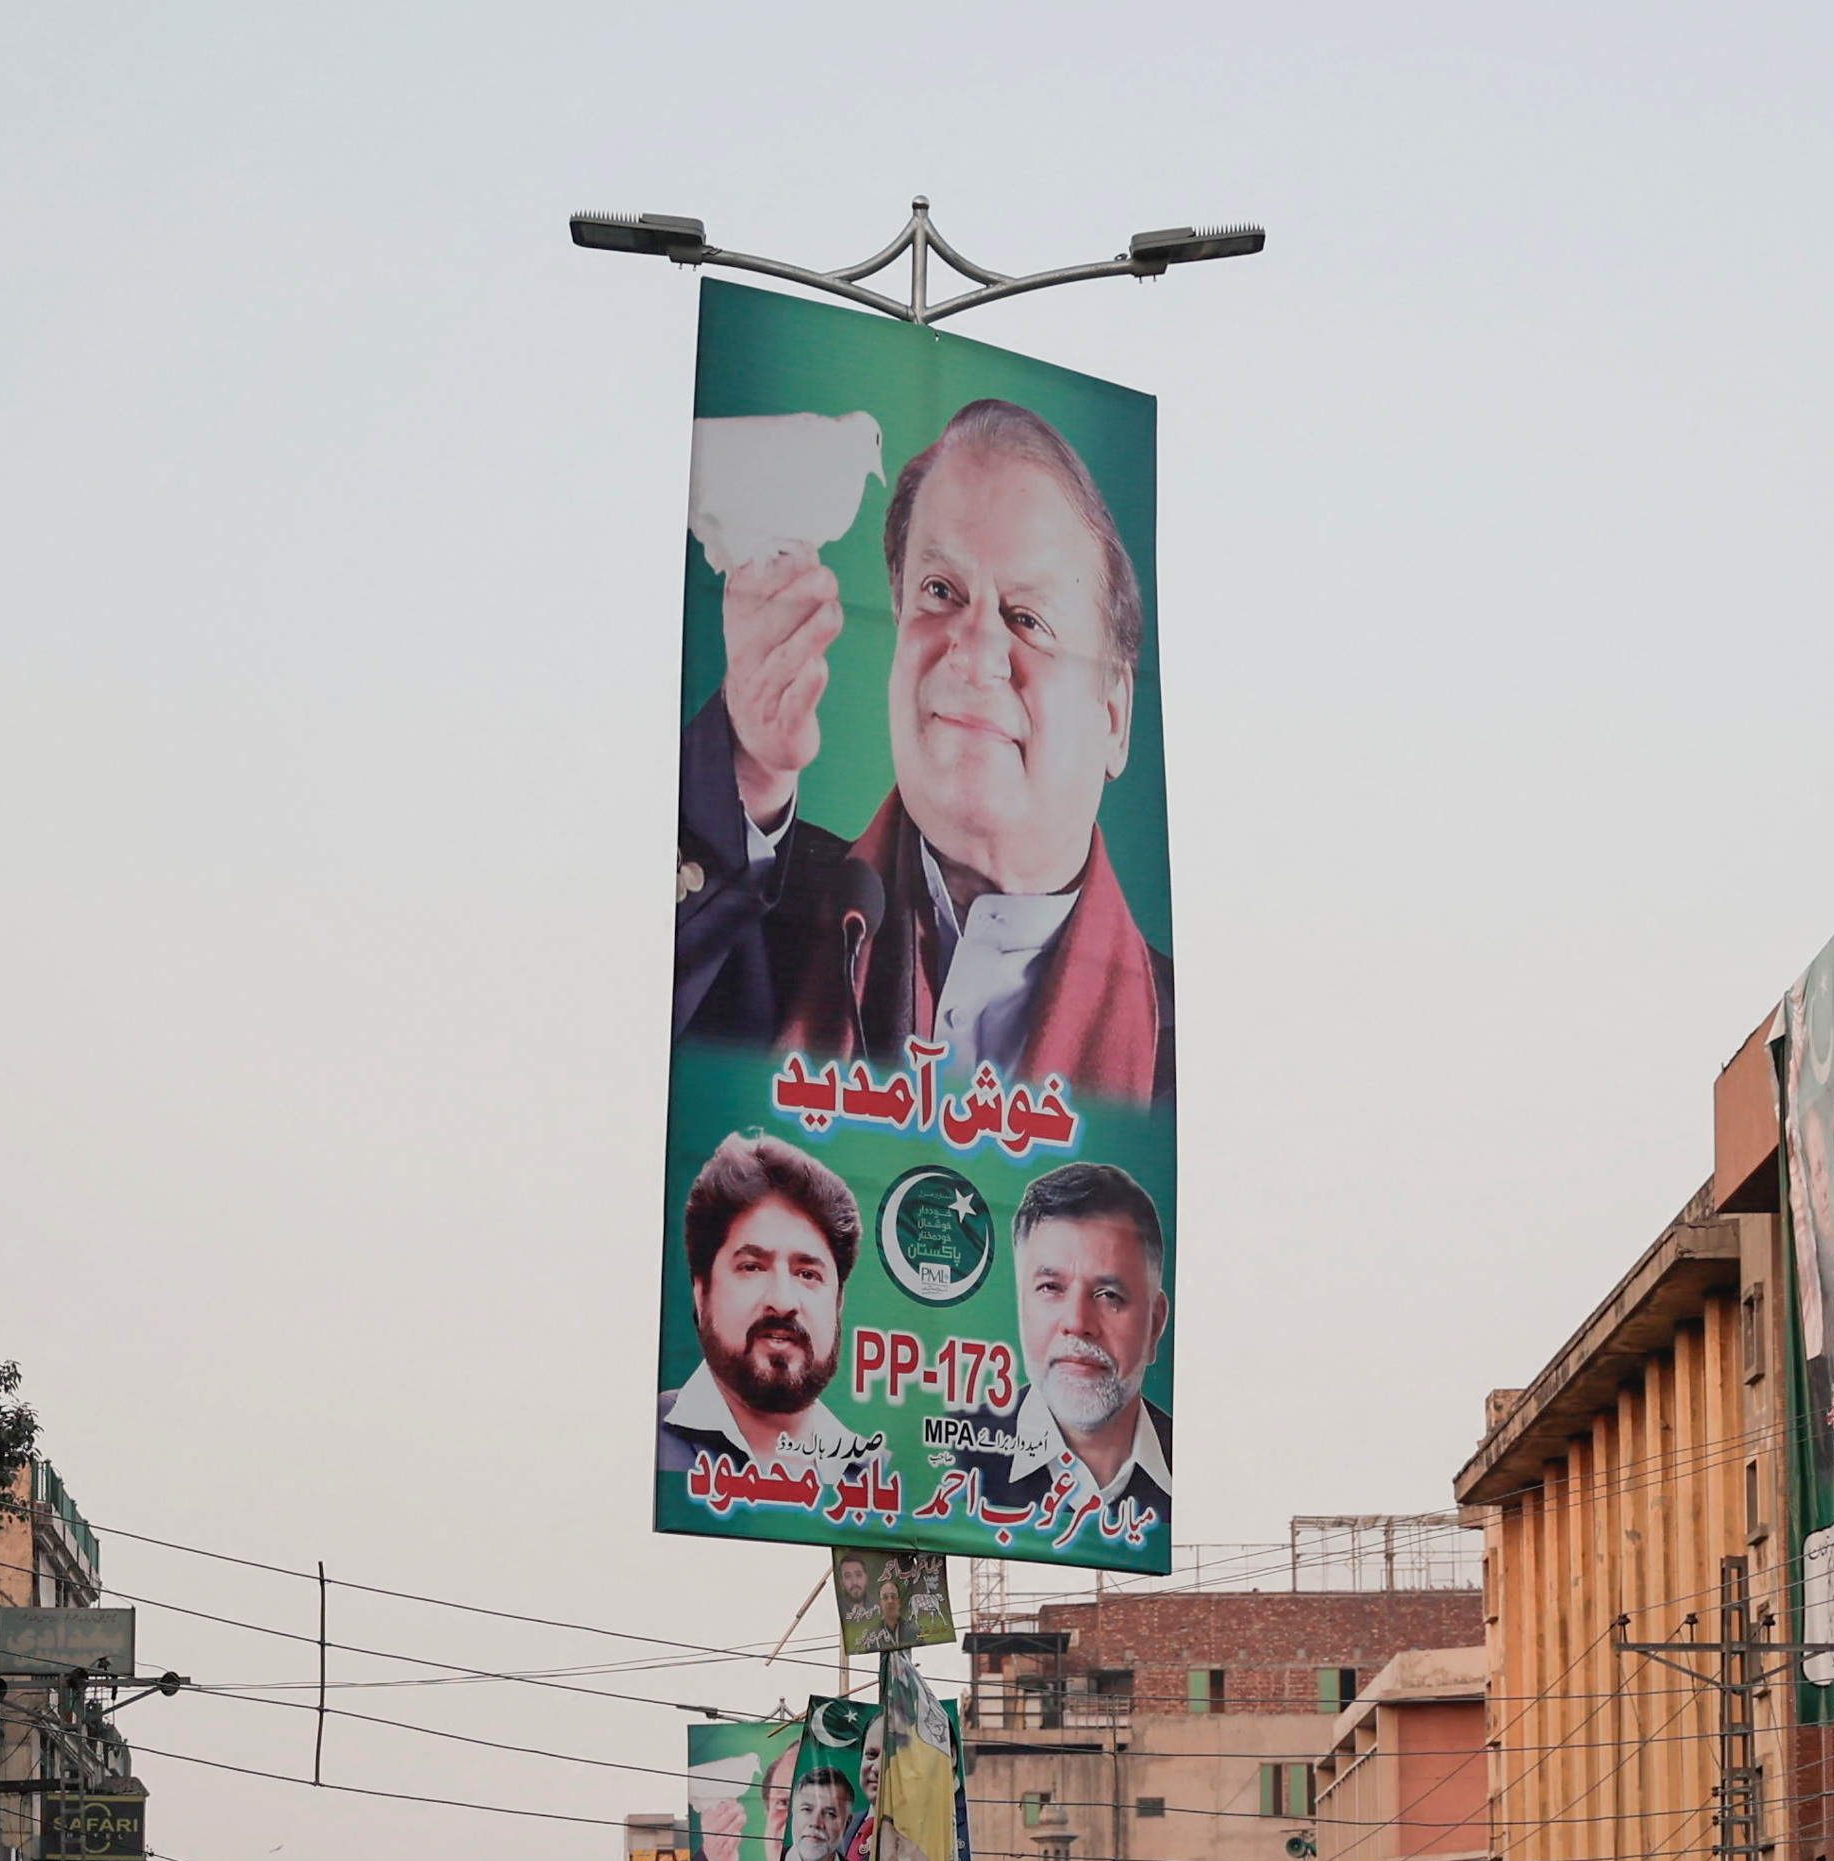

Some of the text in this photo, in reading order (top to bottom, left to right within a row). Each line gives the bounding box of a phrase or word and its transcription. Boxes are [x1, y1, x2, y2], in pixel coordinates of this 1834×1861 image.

[772, 1038, 1079, 1154] خوش آمدید
[908, 1243, 962, 1267] پاکستان
[855, 1329, 1015, 1409] PP-173
[924, 1417, 975, 1448] MPA
[687, 1450, 905, 1527] بابر محمود
[53, 1817, 138, 1832] SAFARI
